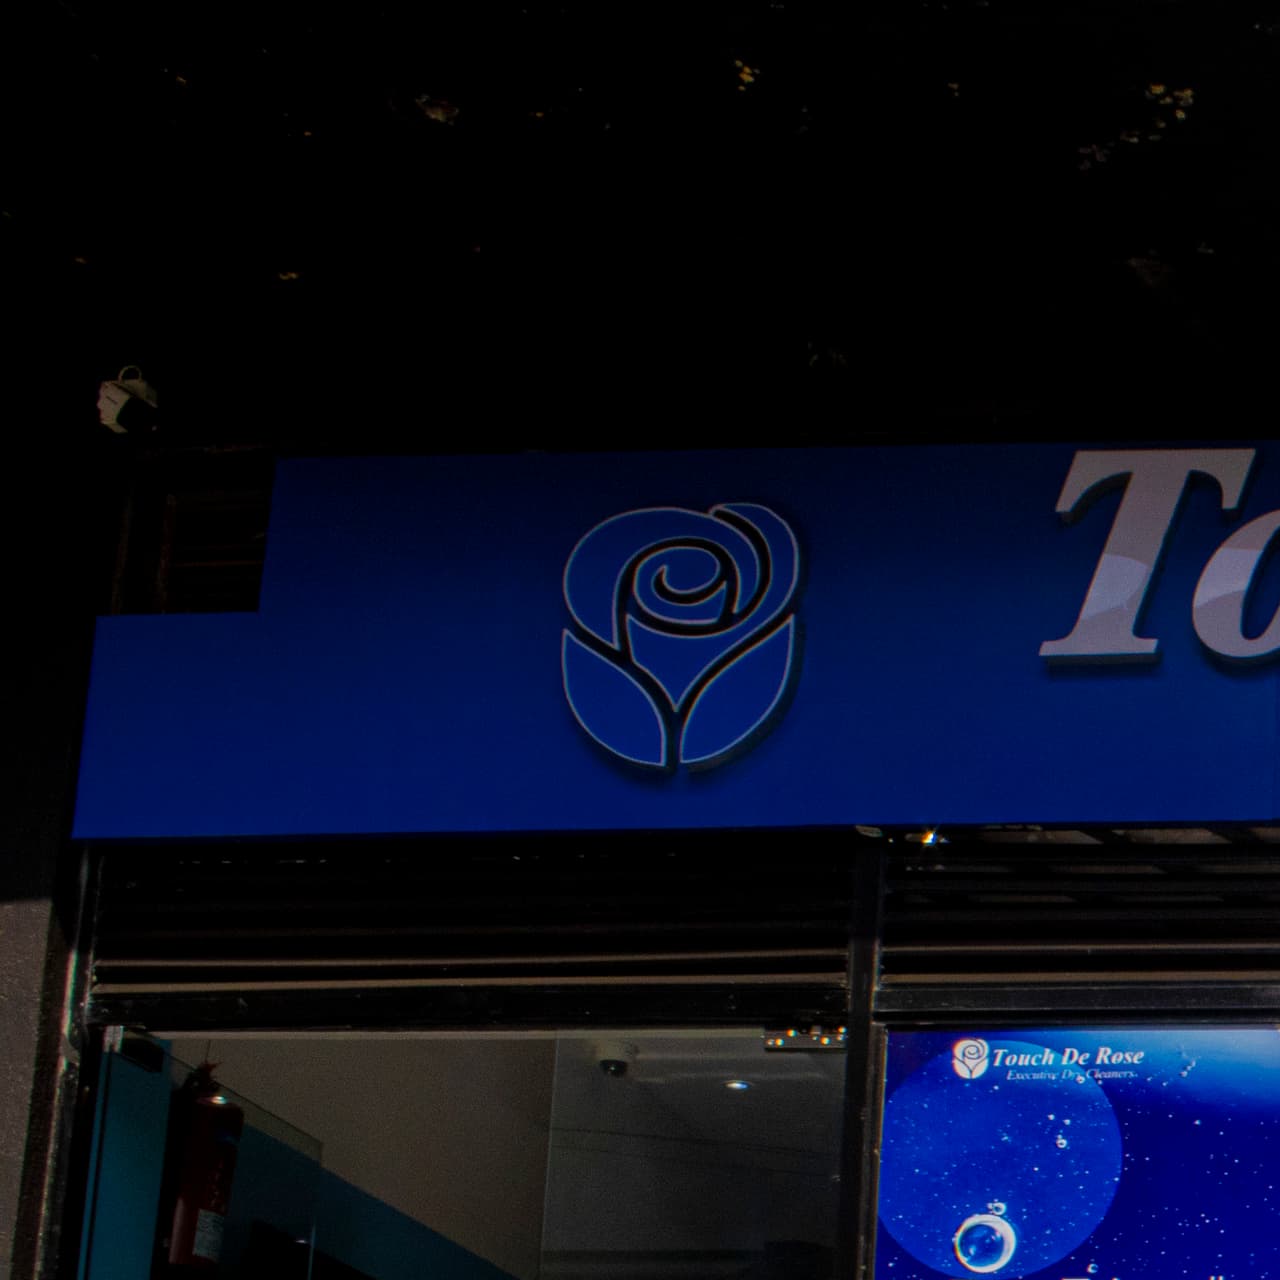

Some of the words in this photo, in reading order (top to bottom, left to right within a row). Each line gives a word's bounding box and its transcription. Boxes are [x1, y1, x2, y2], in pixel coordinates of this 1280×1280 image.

[993, 1047, 1055, 1067] Touch
[1061, 1047, 1090, 1066] De
[1095, 1046, 1145, 1065] Rose
[1006, 1069, 1059, 1081] Executive
[1085, 1068, 1134, 1080] Cleaners
